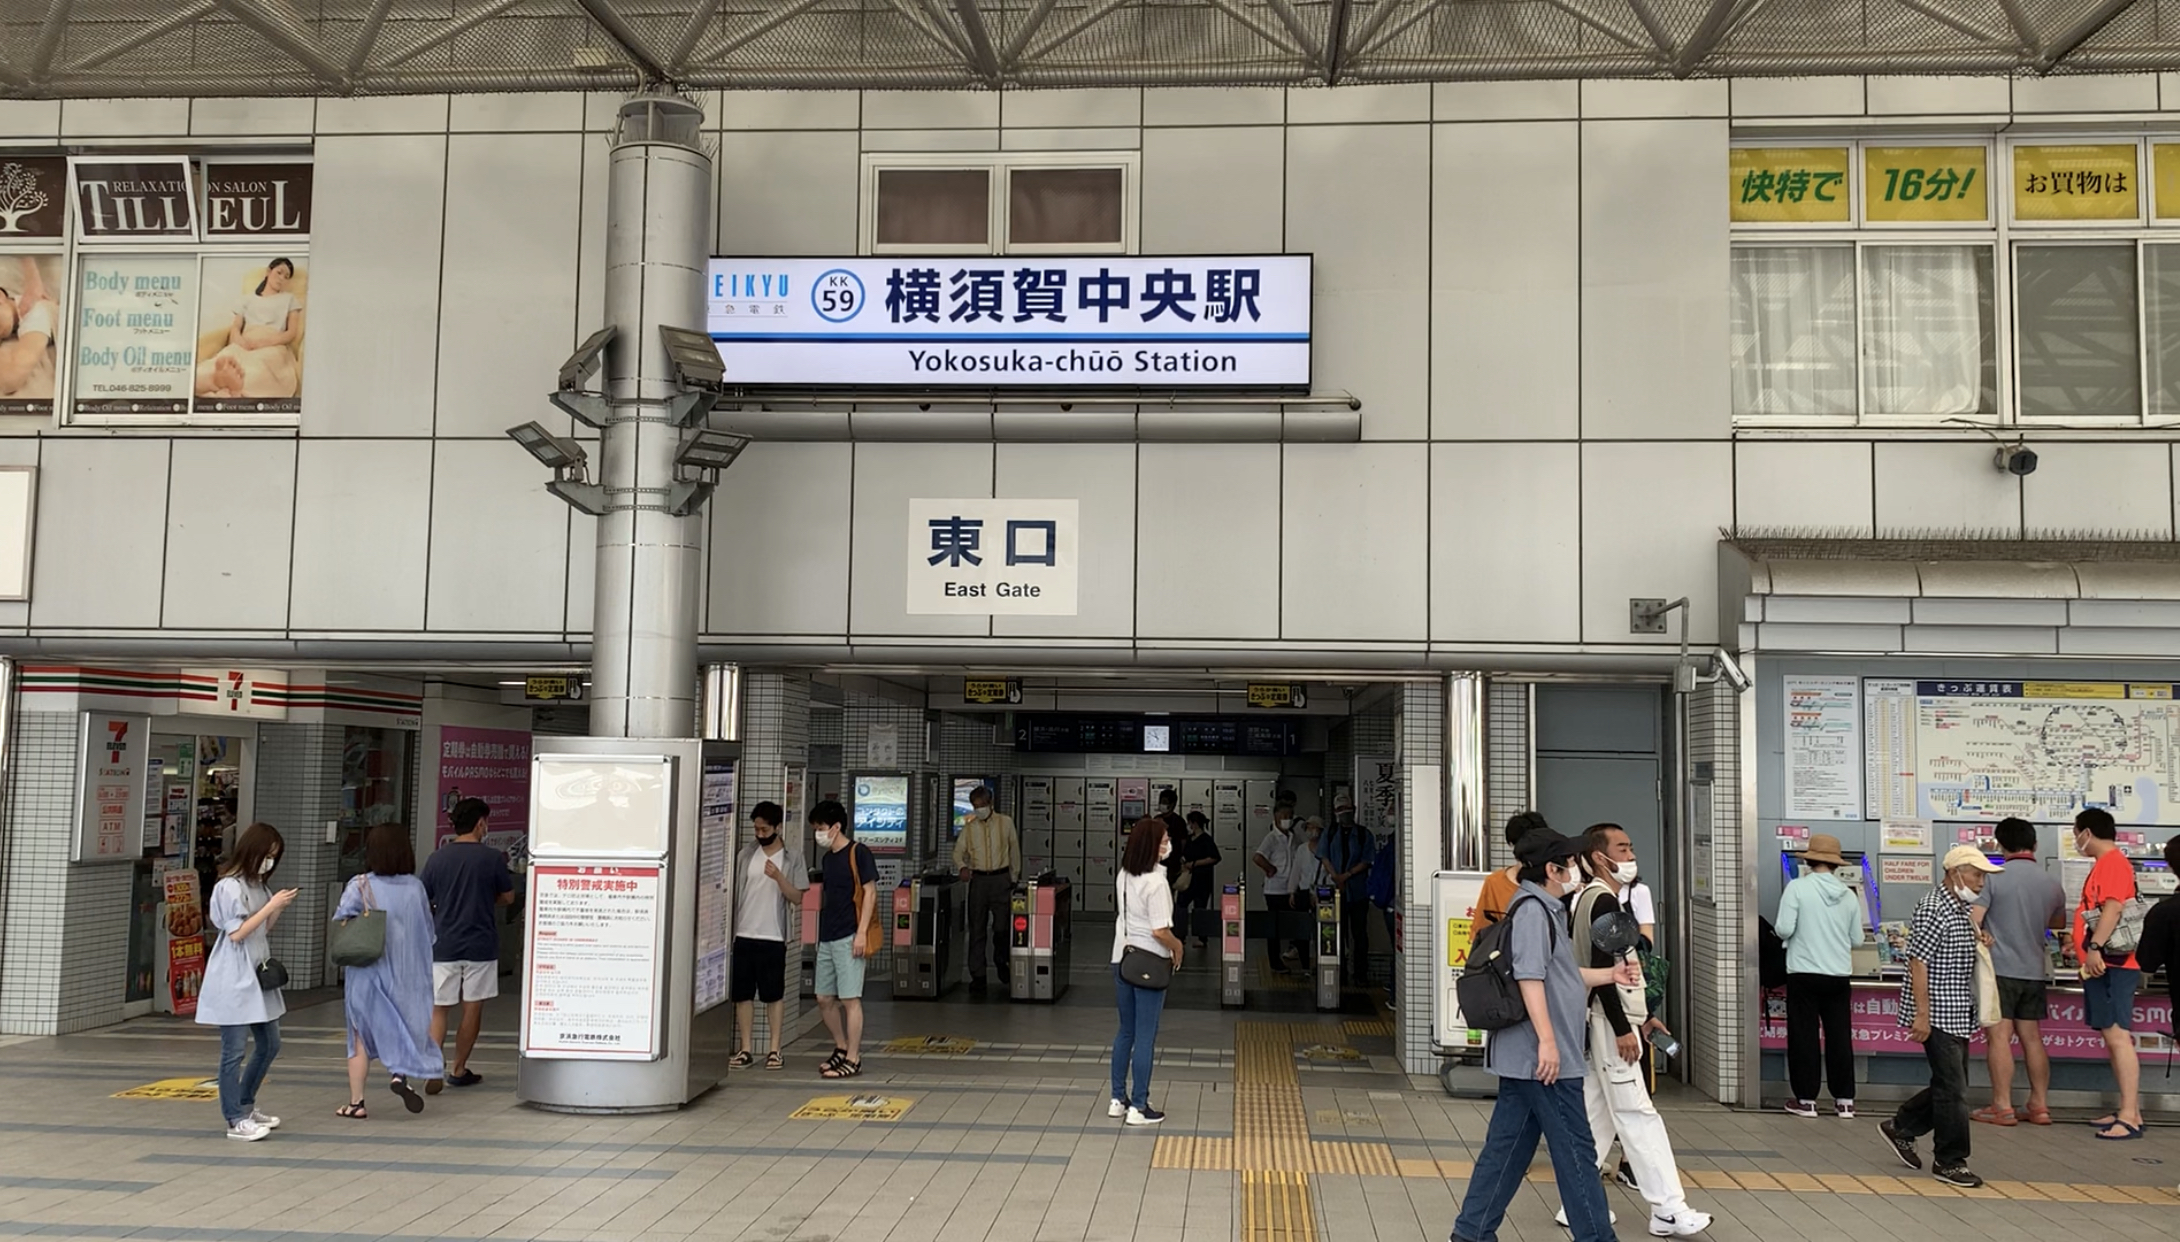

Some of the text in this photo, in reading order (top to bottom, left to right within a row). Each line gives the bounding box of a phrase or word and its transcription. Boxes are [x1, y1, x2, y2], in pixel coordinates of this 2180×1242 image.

[224, 182, 267, 193] SALON
[1741, 168, 1976, 204] 快特で 16分!
[2024, 170, 2128, 196] お買物は
[85, 271, 182, 295] Body menu
[715, 273, 789, 298] EIKYU
[829, 276, 849, 287] KK
[822, 290, 855, 312] 59
[885, 267, 1261, 323] 横須賀中央駅
[709, 303, 786, 315] 急電鉄
[82, 307, 174, 328] Foot menu
[80, 346, 192, 371] Body Oil menu
[908, 349, 1237, 372] Yokosuka-chūō Station
[927, 515, 1056, 567] 東口
[944, 582, 1041, 597] East Gate
[1936, 682, 2013, 694] きっぷ運賃表
[1018, 729, 1028, 741] 2
[1289, 734, 1296, 746] 1
[103, 822, 121, 831] ATM
[557, 878, 638, 891] 特別警戒実施中
[896, 897, 908, 908] IC
[1225, 904, 1238, 915] IC
[1851, 998, 1899, 1016] は自動
[1760, 1026, 1788, 1040] 期券
